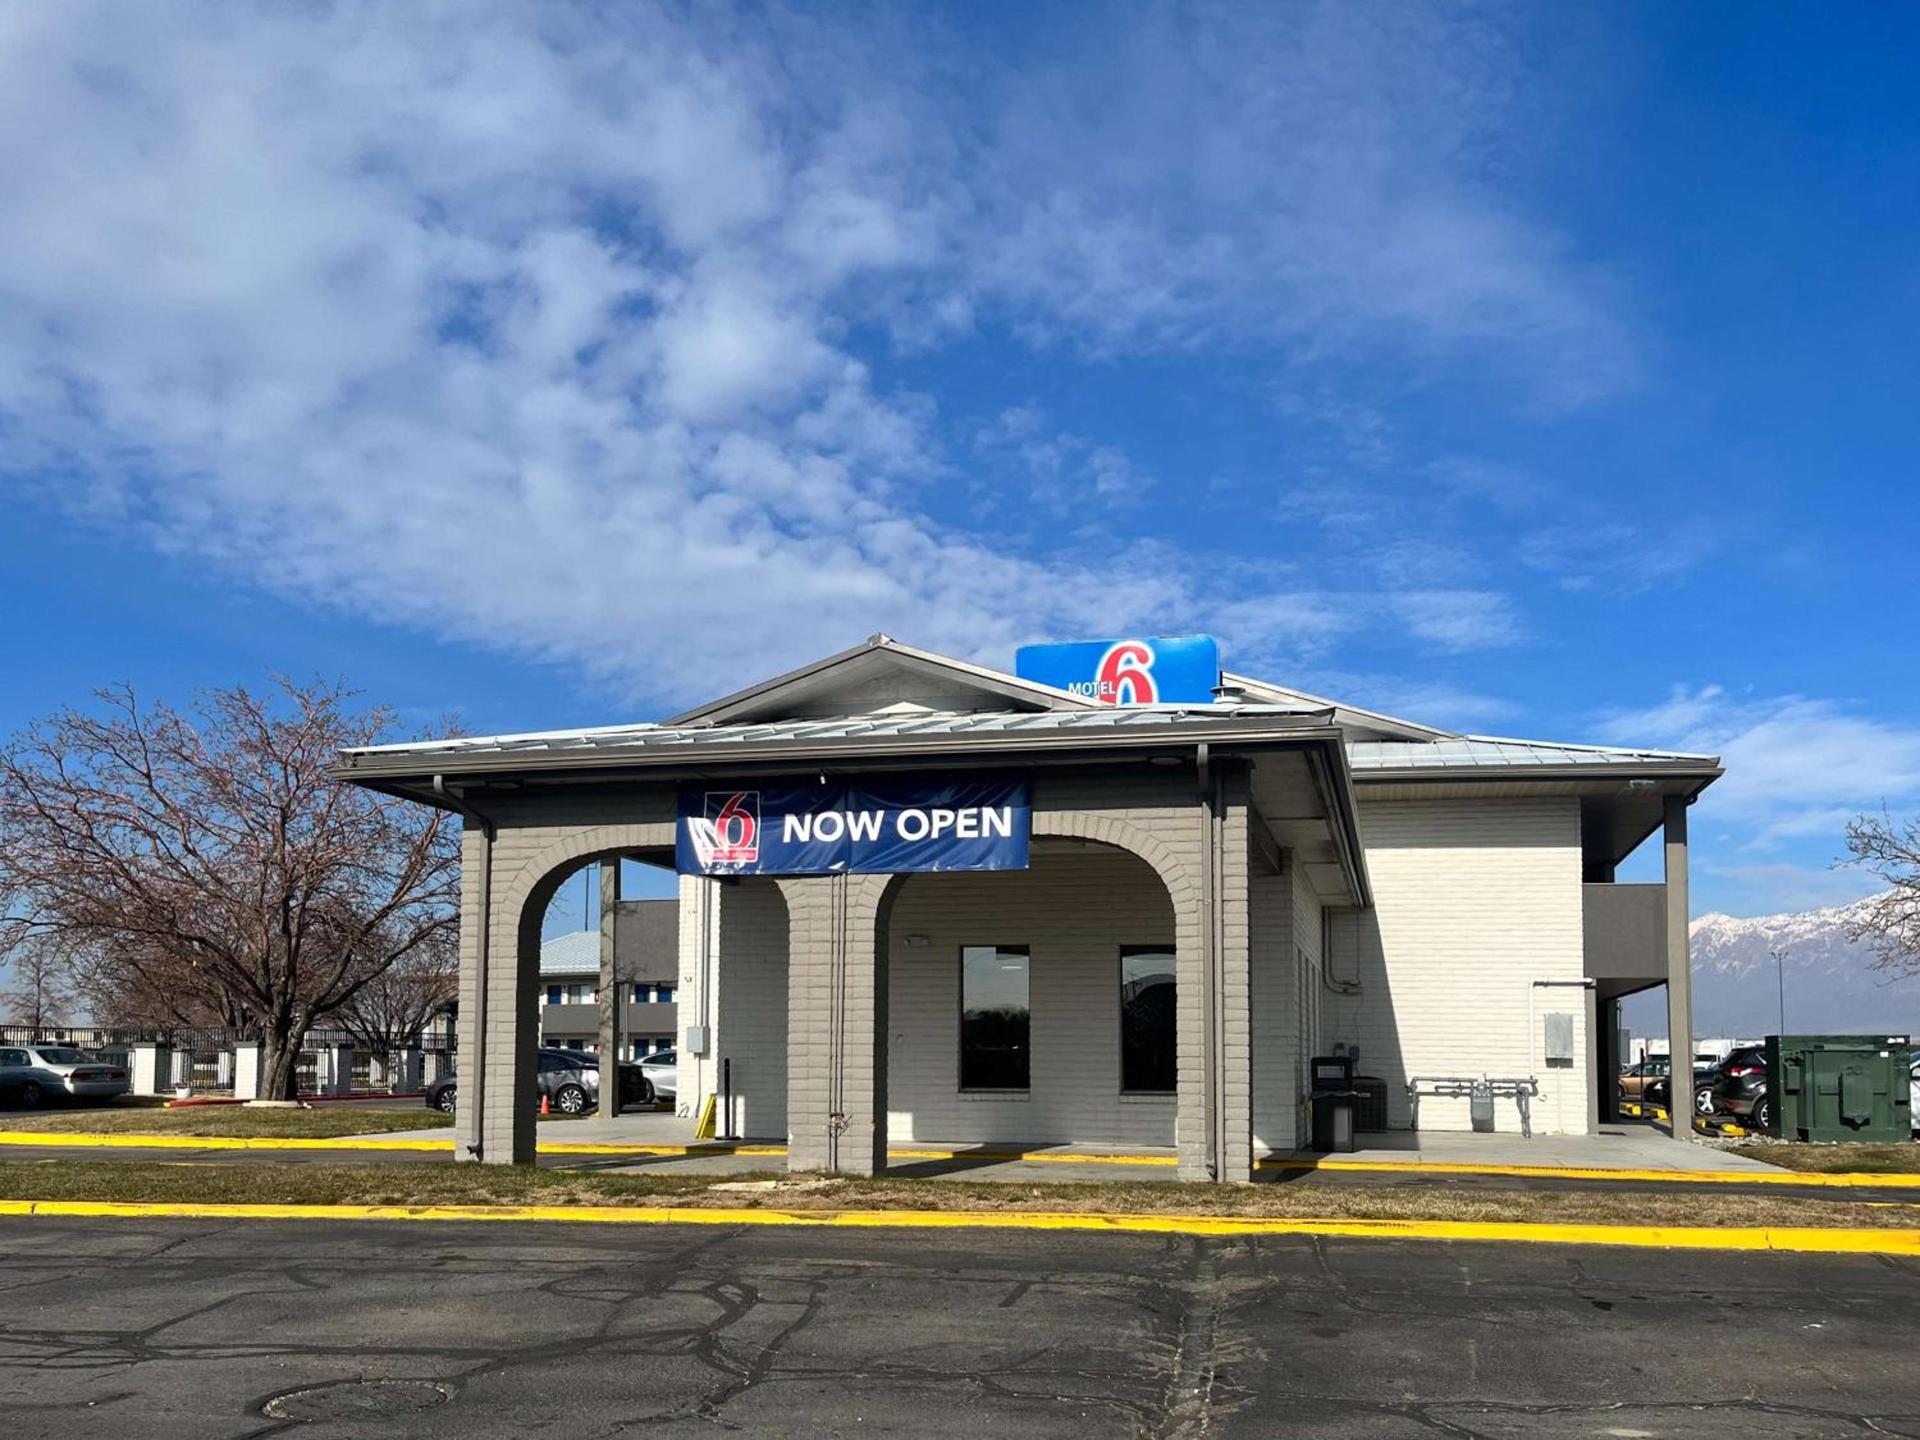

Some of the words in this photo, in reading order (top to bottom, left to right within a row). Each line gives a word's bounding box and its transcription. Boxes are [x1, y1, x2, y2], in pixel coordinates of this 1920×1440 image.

[1068, 681, 1116, 696] MOTEL
[1095, 640, 1159, 705] 6
[782, 810, 885, 843] NOW
[896, 806, 1012, 841] OPEN
